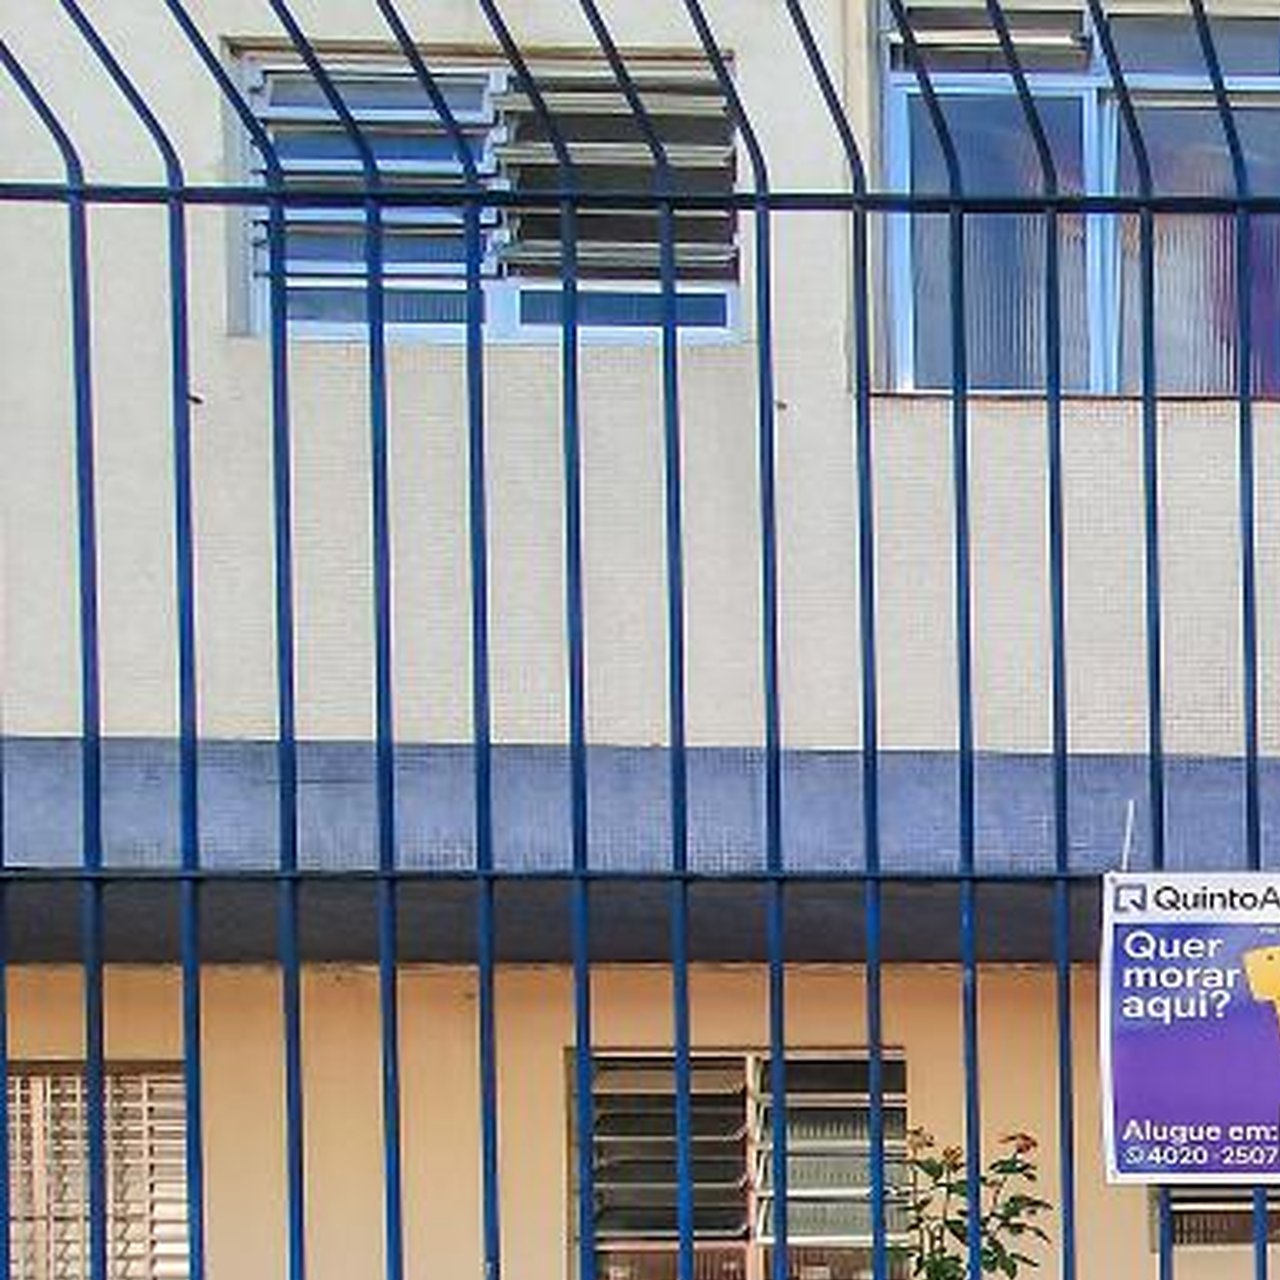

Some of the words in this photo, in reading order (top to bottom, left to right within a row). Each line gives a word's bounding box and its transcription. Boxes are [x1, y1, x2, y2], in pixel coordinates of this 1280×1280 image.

[1123, 931, 1223, 961] Quer
[1122, 967, 1241, 988] morar
[1122, 990, 1231, 1024] aqui?
[1122, 1120, 1222, 1145] Alugue
[1228, 1125, 1279, 1142] em:
